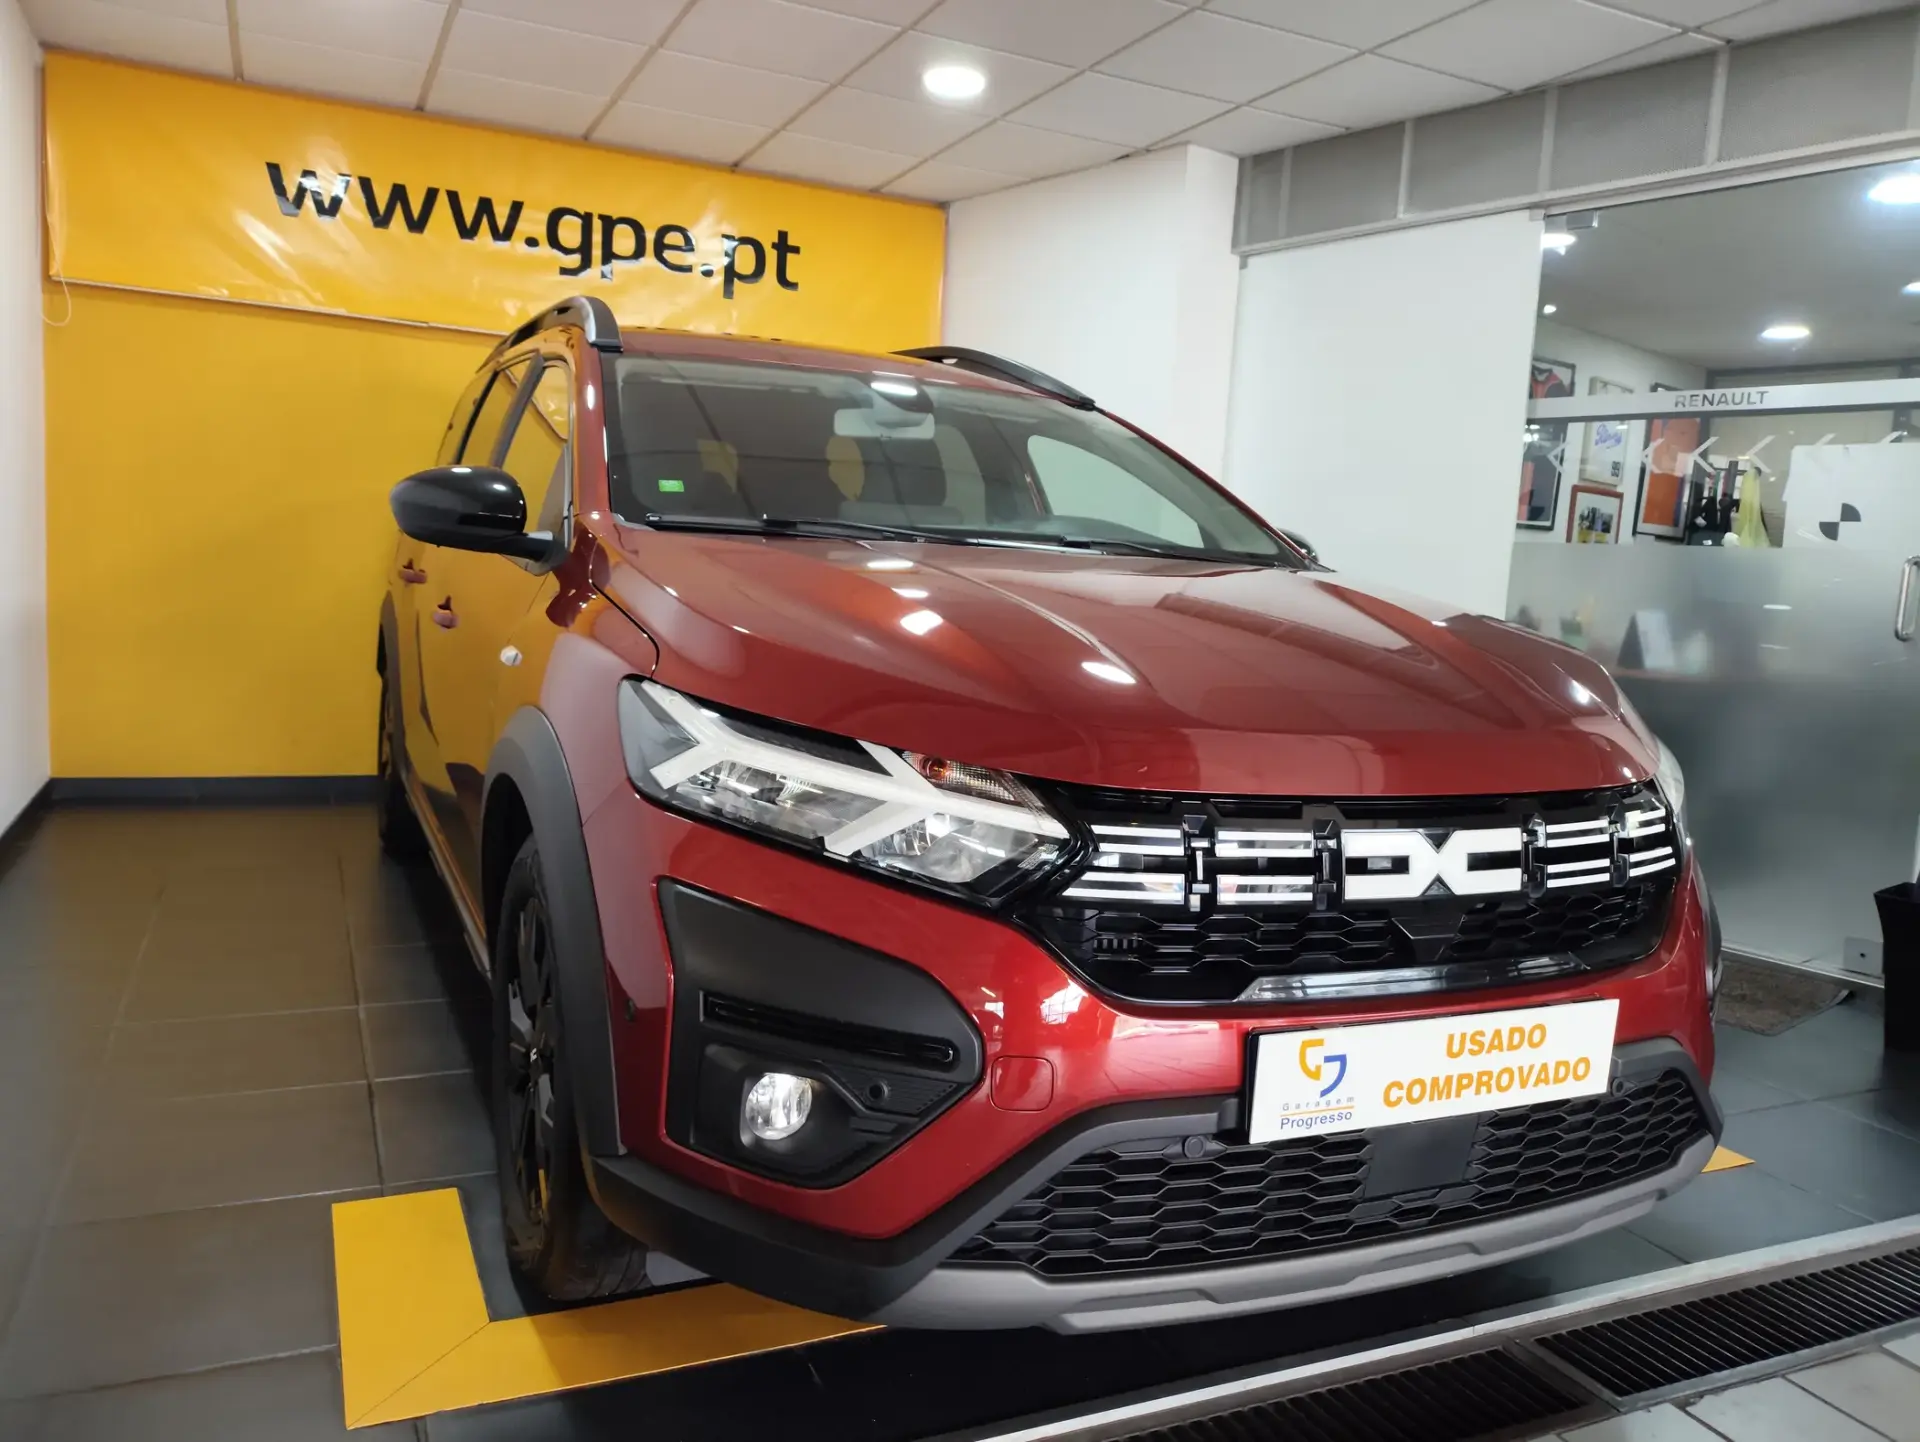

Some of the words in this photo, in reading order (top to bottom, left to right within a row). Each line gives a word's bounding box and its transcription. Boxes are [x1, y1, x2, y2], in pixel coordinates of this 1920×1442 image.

[265, 161, 800, 299] www.gpe.pt
[1674, 390, 1769, 408] RENAULT
[1445, 1023, 1547, 1059] USADO
[1382, 1056, 1592, 1108] COMPROVADO
[1282, 1096, 1355, 1112] Garagem
[1280, 1111, 1353, 1130] Progresso
